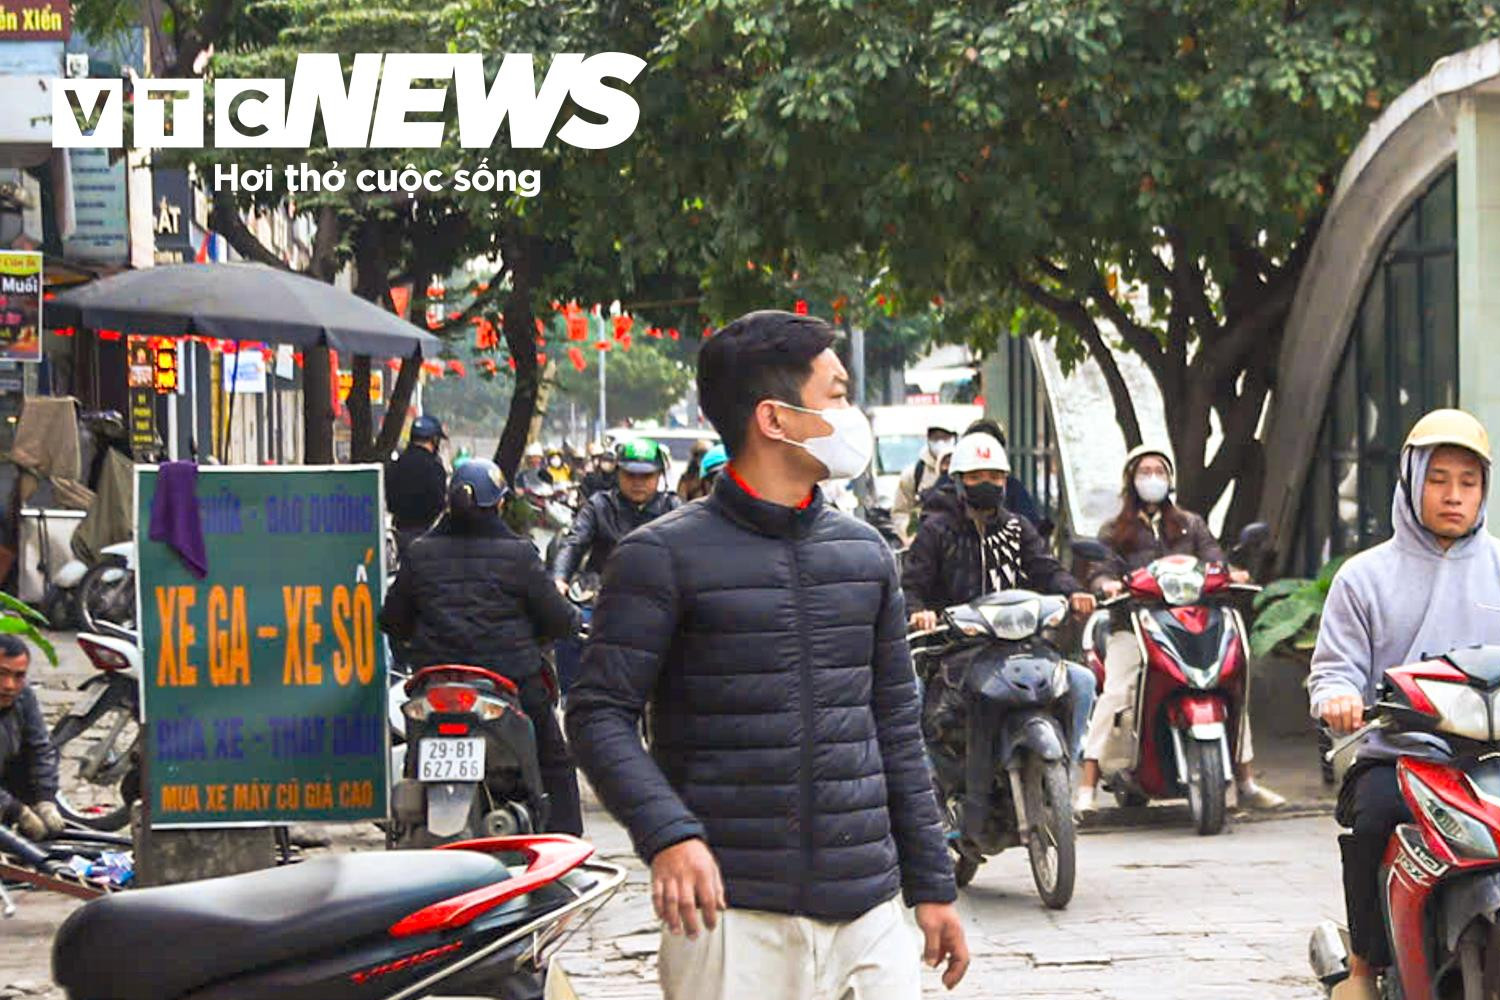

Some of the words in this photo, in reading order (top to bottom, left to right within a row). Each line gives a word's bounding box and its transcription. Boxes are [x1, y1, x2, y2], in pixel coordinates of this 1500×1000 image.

[155, 585, 198, 687] XE
[208, 584, 251, 687] GA
[282, 585, 323, 686] XE
[331, 548, 375, 686] SỐ
[161, 783, 200, 812] MUA
[206, 783, 227, 812] XE
[339, 780, 373, 808] CAO
